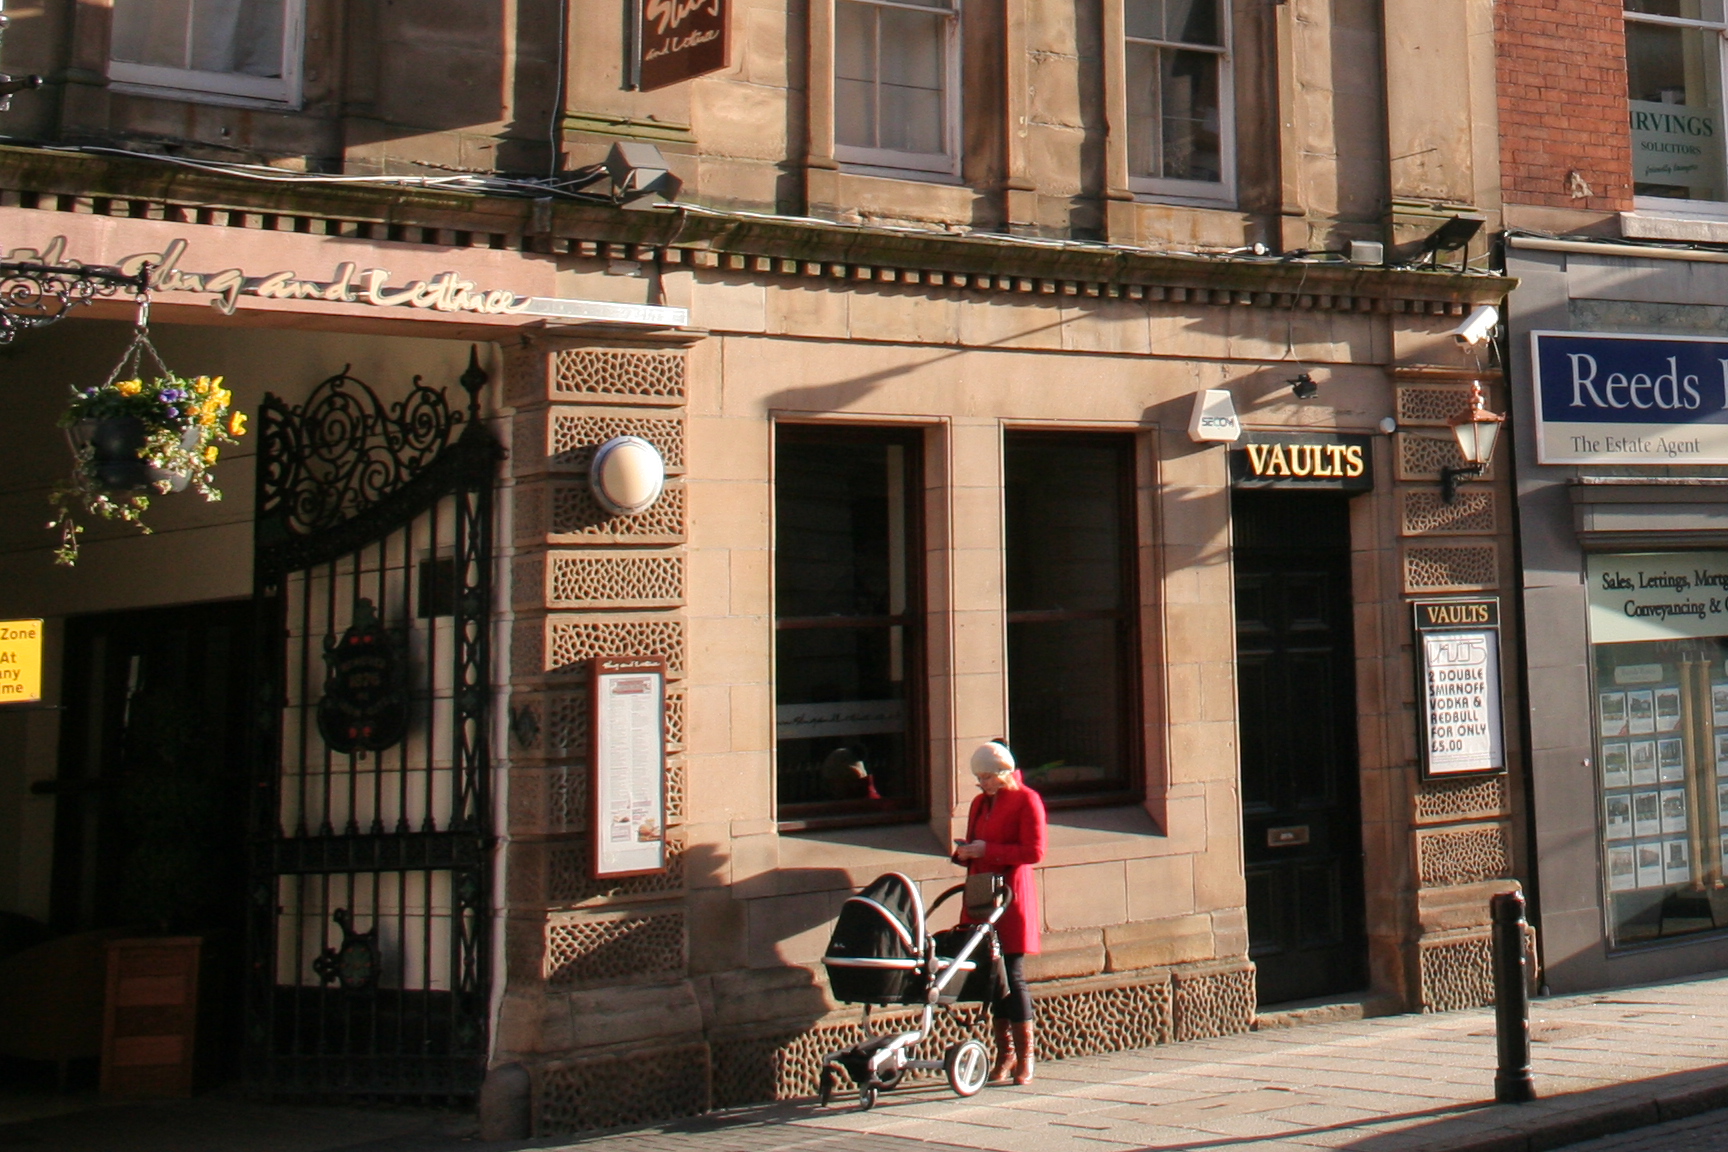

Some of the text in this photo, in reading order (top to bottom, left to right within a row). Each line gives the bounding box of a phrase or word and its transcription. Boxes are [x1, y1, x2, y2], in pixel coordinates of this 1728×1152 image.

[1629, 110, 1713, 137] IRVINGS
[1640, 141, 1702, 156] SOLICITORS
[257, 261, 357, 301] and
[1566, 352, 1701, 410] Reeds
[1201, 416, 1235, 428] SECOM
[1570, 436, 1701, 458] The Estate Agent
[1245, 442, 1365, 478] VAULTS
[1602, 571, 1635, 592] Sales,
[1638, 570, 1691, 593] Lettings,
[1427, 604, 1489, 624] VAULTS
[1624, 598, 1706, 621] Conveyancing
[1709, 598, 1722, 614] &
[0, 628, 36, 640] Zone
[0, 651, 17, 663] At
[1426, 638, 1488, 668] VAULTS
[0, 669, 21, 681] ny
[1428, 668, 1483, 683] 2 DOUBLE
[1429, 682, 1486, 697] SMIRNOFF
[1430, 696, 1482, 711] VODKA &
[1431, 710, 1478, 725] REDBULL
[1431, 723, 1487, 739] FOR ONLY
[1431, 739, 1463, 753] £5.00
